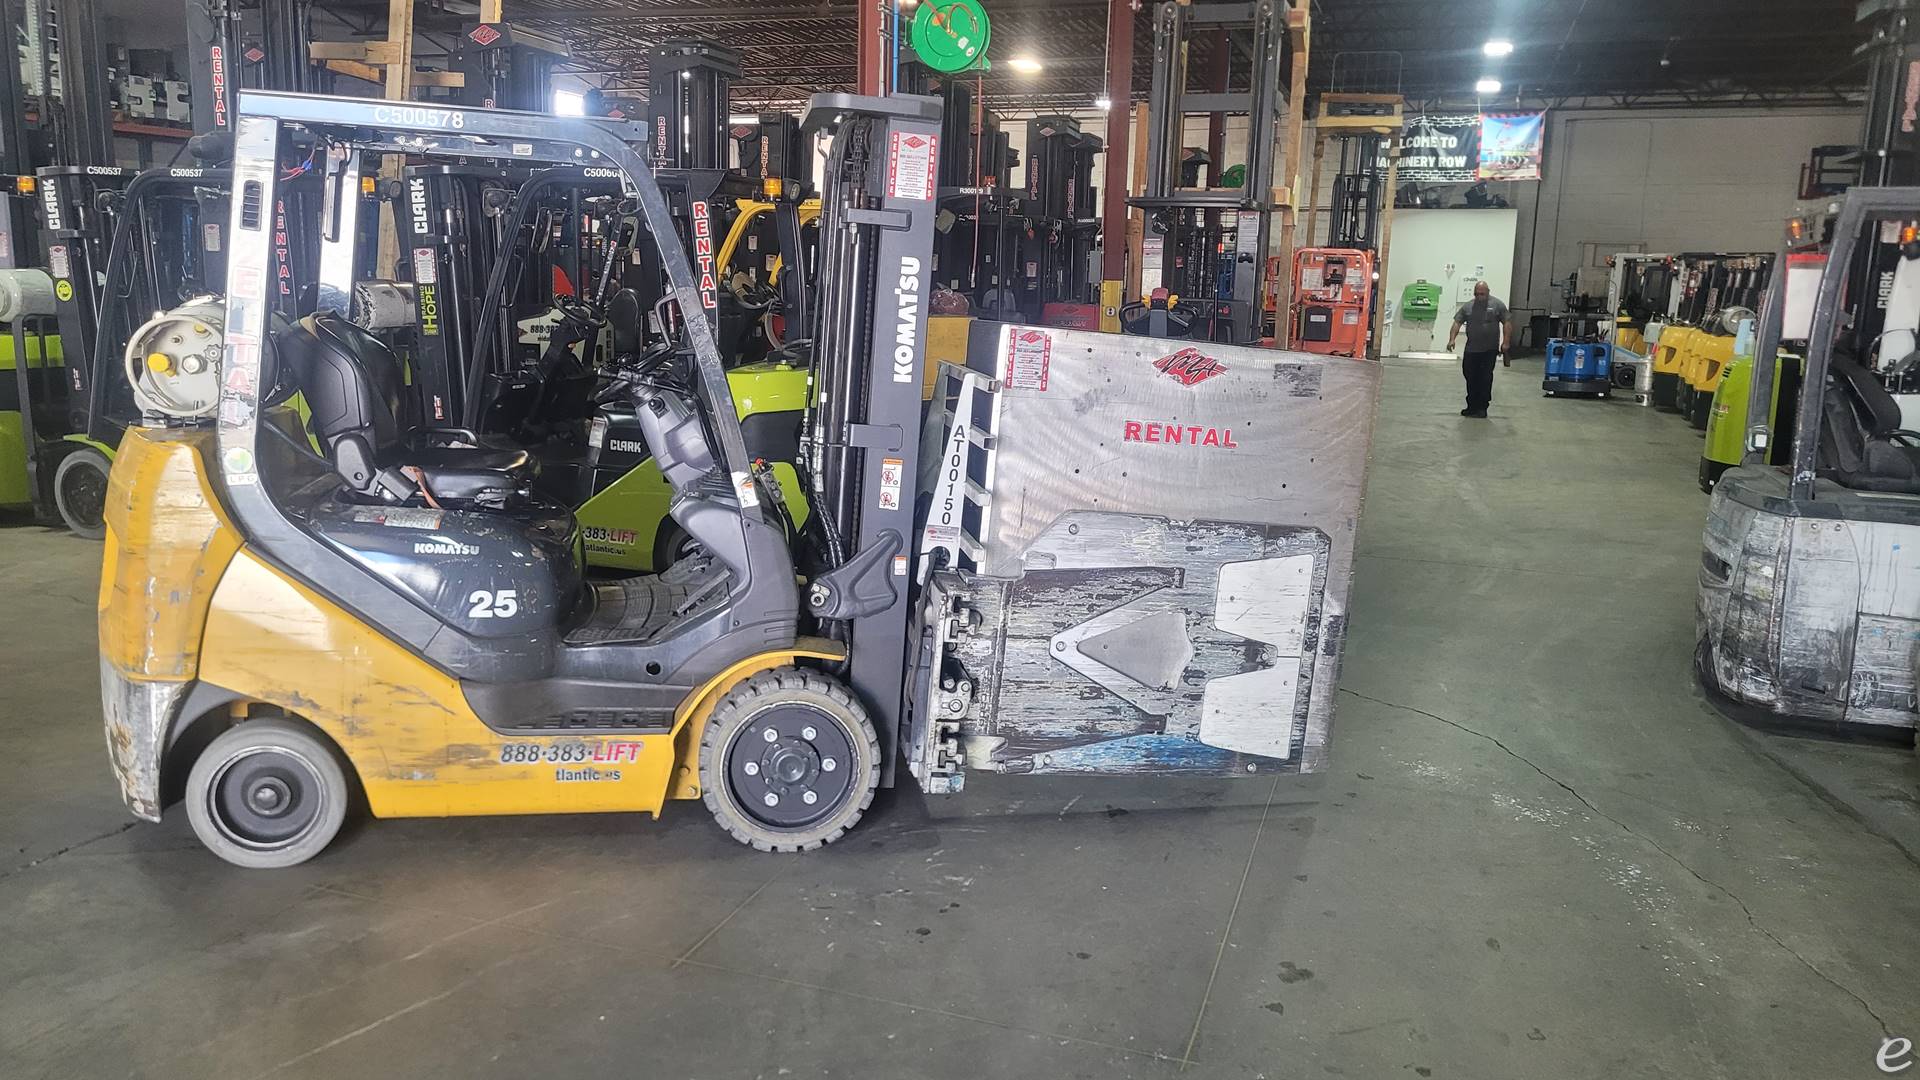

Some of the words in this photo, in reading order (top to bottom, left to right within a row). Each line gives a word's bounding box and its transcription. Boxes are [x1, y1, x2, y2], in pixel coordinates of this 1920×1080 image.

[212, 46, 226, 126] RENTAL
[374, 107, 464, 129] C500578
[657, 116, 667, 169] RENTA
[889, 134, 899, 194] SERVICE
[1380, 136, 1439, 150] WLCOME
[1440, 136, 1458, 149] TO
[1437, 155, 1468, 168] ROW
[86, 166, 122, 176] C500537
[170, 168, 203, 177] C500537
[926, 138, 937, 197] RENTALS
[43, 178, 61, 230] CLARK
[410, 178, 428, 234] CLARK
[693, 201, 716, 309] RENTAL
[422, 285, 438, 329] HOPE
[893, 256, 921, 383] KOMATSU
[610, 439, 641, 453] CLARK
[1124, 420, 1238, 449] RENTAL
[941, 424, 966, 526] AT00150
[414, 543, 480, 555] KOMATSU
[468, 589, 518, 618] 25
